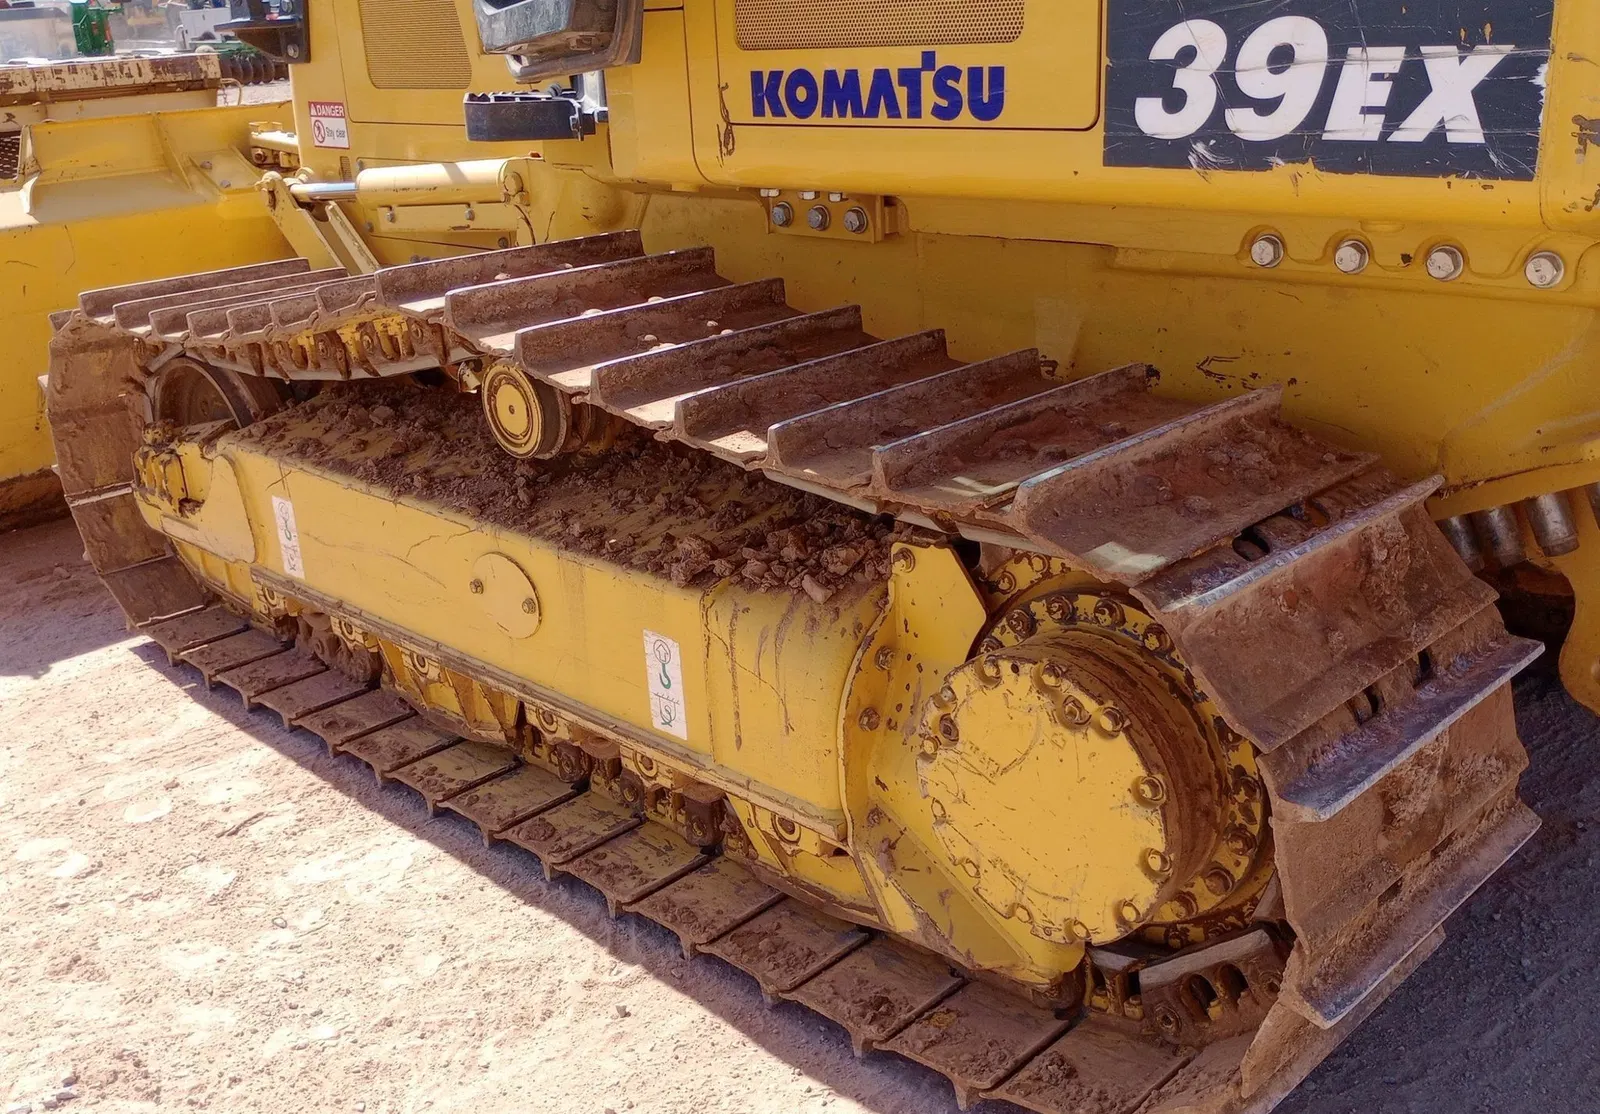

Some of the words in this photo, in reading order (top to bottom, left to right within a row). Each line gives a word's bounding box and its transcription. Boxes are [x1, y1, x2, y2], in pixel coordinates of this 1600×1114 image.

[316, 104, 345, 117] DANGER
[750, 51, 1005, 121] KOMATSU
[1134, 16, 1515, 143] 39EX
